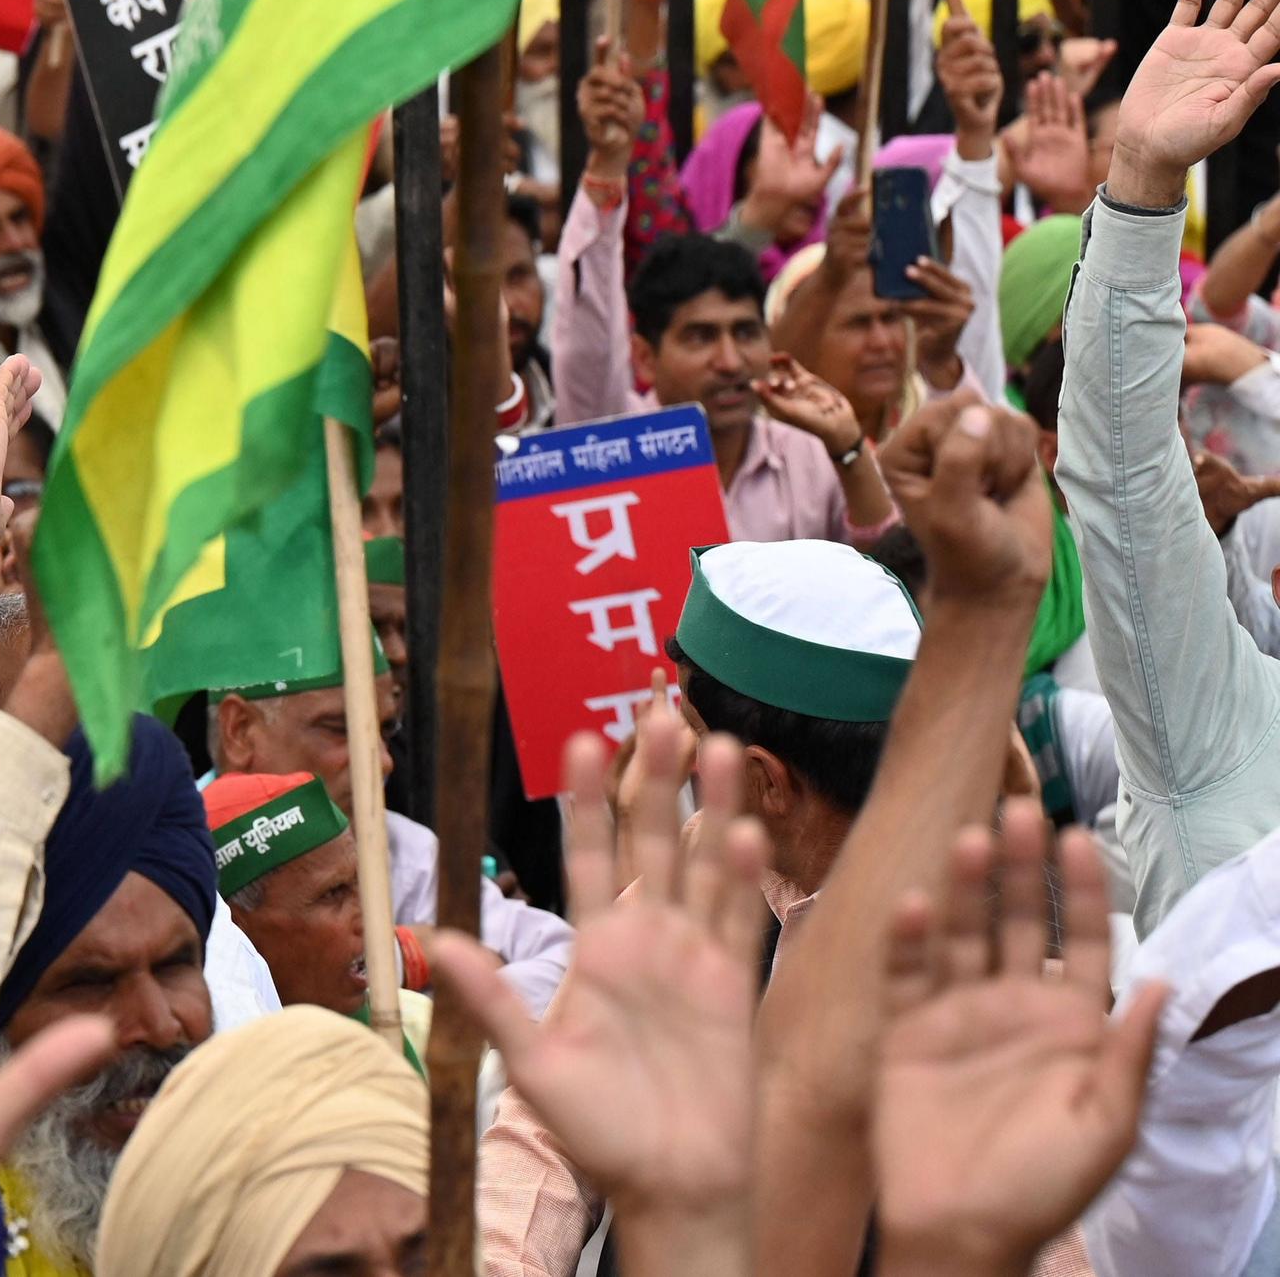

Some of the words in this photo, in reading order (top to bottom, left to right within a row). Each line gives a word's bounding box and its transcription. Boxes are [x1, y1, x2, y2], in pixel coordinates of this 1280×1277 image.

[571, 433, 632, 472] महिला
[636, 425, 698, 459] संगठन
[241, 806, 305, 854] यूनियन
